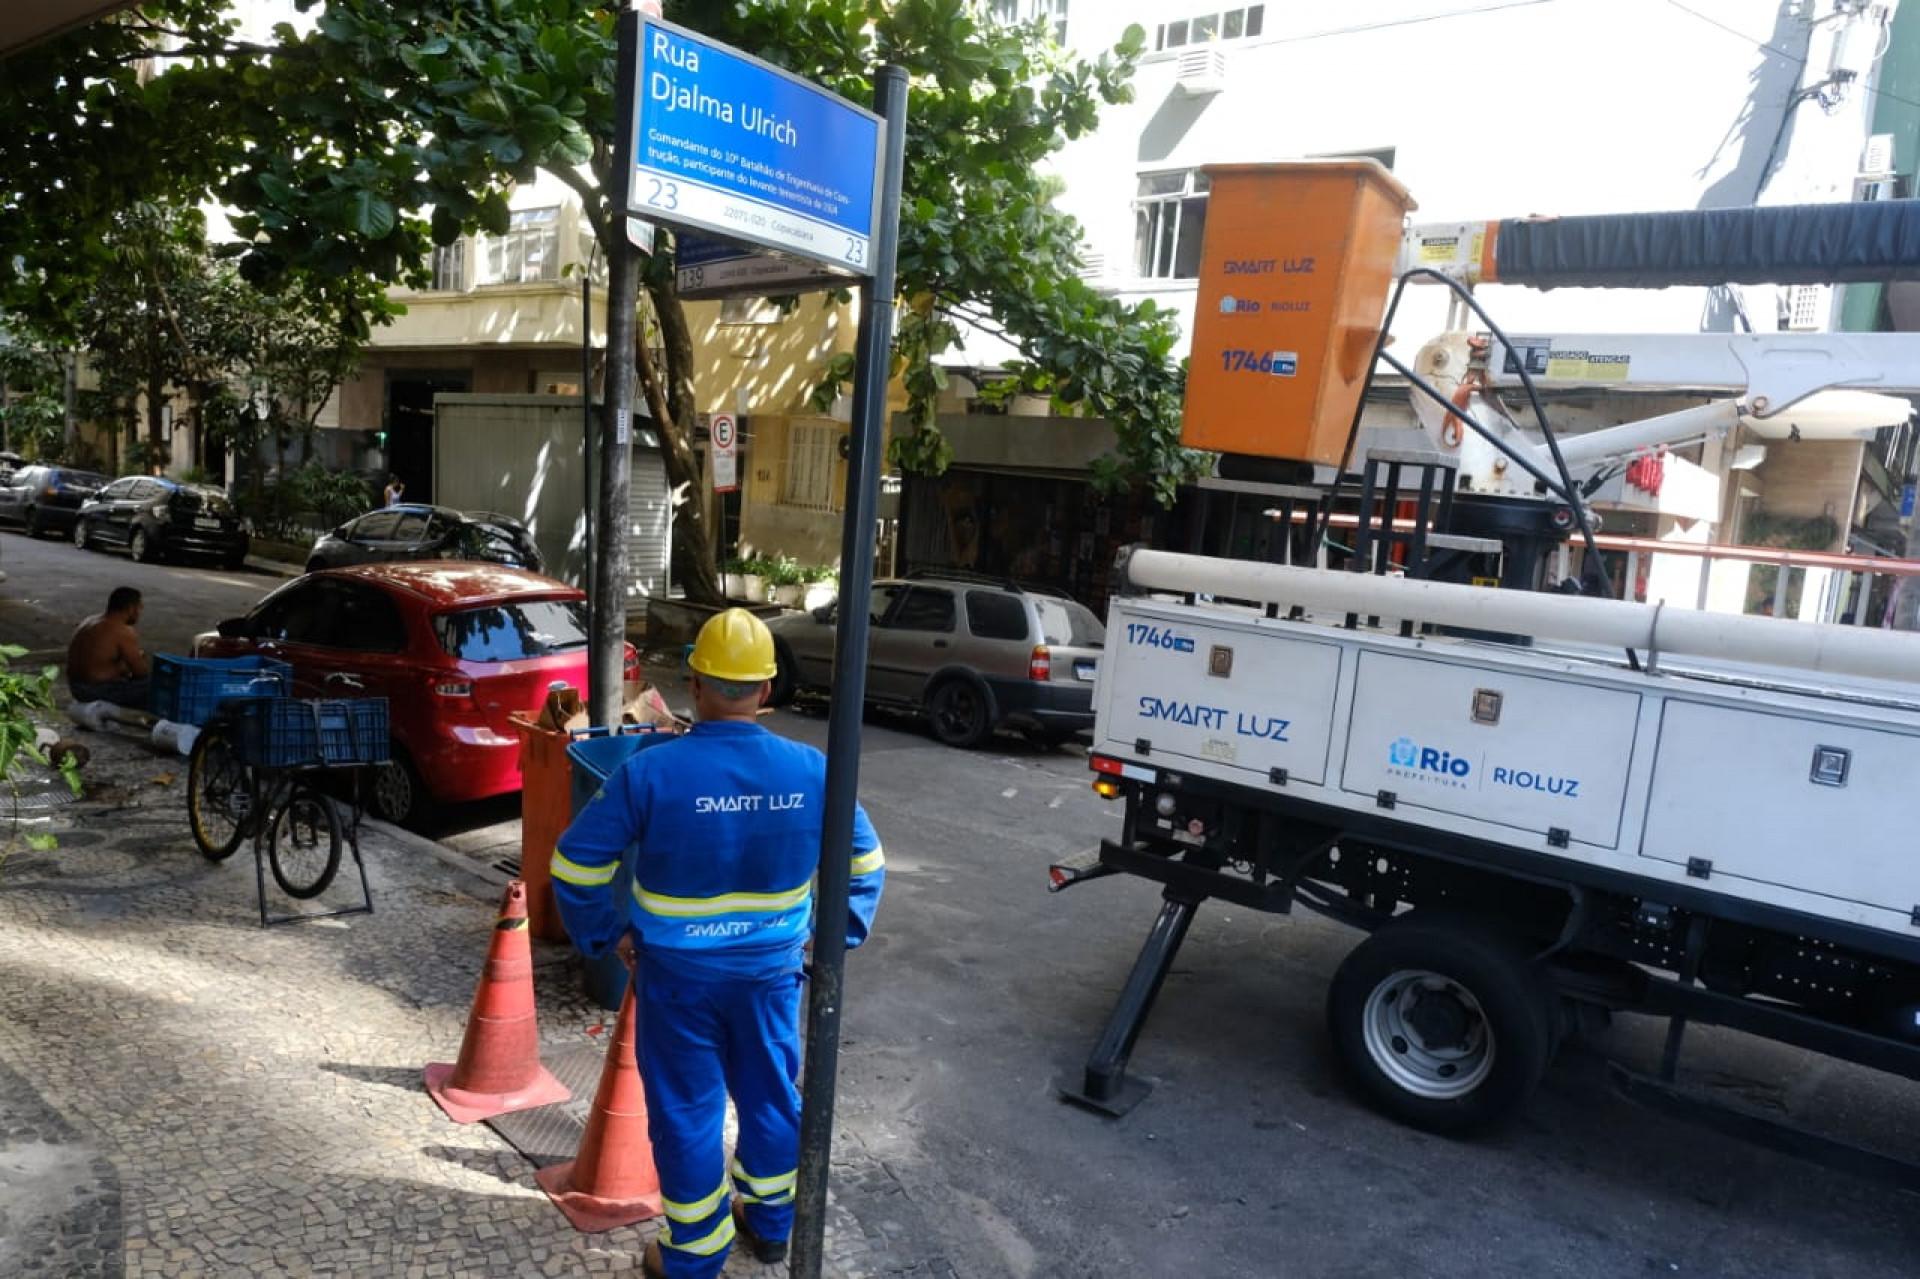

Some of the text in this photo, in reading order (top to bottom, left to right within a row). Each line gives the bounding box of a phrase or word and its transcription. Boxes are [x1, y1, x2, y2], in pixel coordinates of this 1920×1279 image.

[653, 33, 699, 73] Rua
[651, 73, 796, 147] Djalma Ulrich
[648, 128, 709, 156] Comandante
[710, 146, 722, 160] do
[741, 156, 775, 178] Batalhão
[775, 169, 785, 181] de
[648, 146, 680, 165] trução,
[683, 158, 735, 181] participante
[736, 172, 748, 185] do
[749, 175, 778, 196] levante
[647, 178, 678, 210] 23
[845, 236, 863, 263] 23
[681, 265, 704, 290] 139
[1223, 257, 1316, 275] SMART LUZ
[1236, 299, 1260, 313] Rio
[1271, 301, 1311, 313] RIOLUZ
[1222, 349, 1272, 374] 1746
[1127, 623, 1173, 649] 1746
[1139, 696, 1290, 742] SMART LUZ
[1419, 747, 1470, 777] Rio
[1386, 767, 1468, 790] PREFEITURA
[1493, 767, 1580, 797] RIOLUZ
[695, 793, 804, 814] SMART LUZ
[685, 921, 753, 937] SMART
